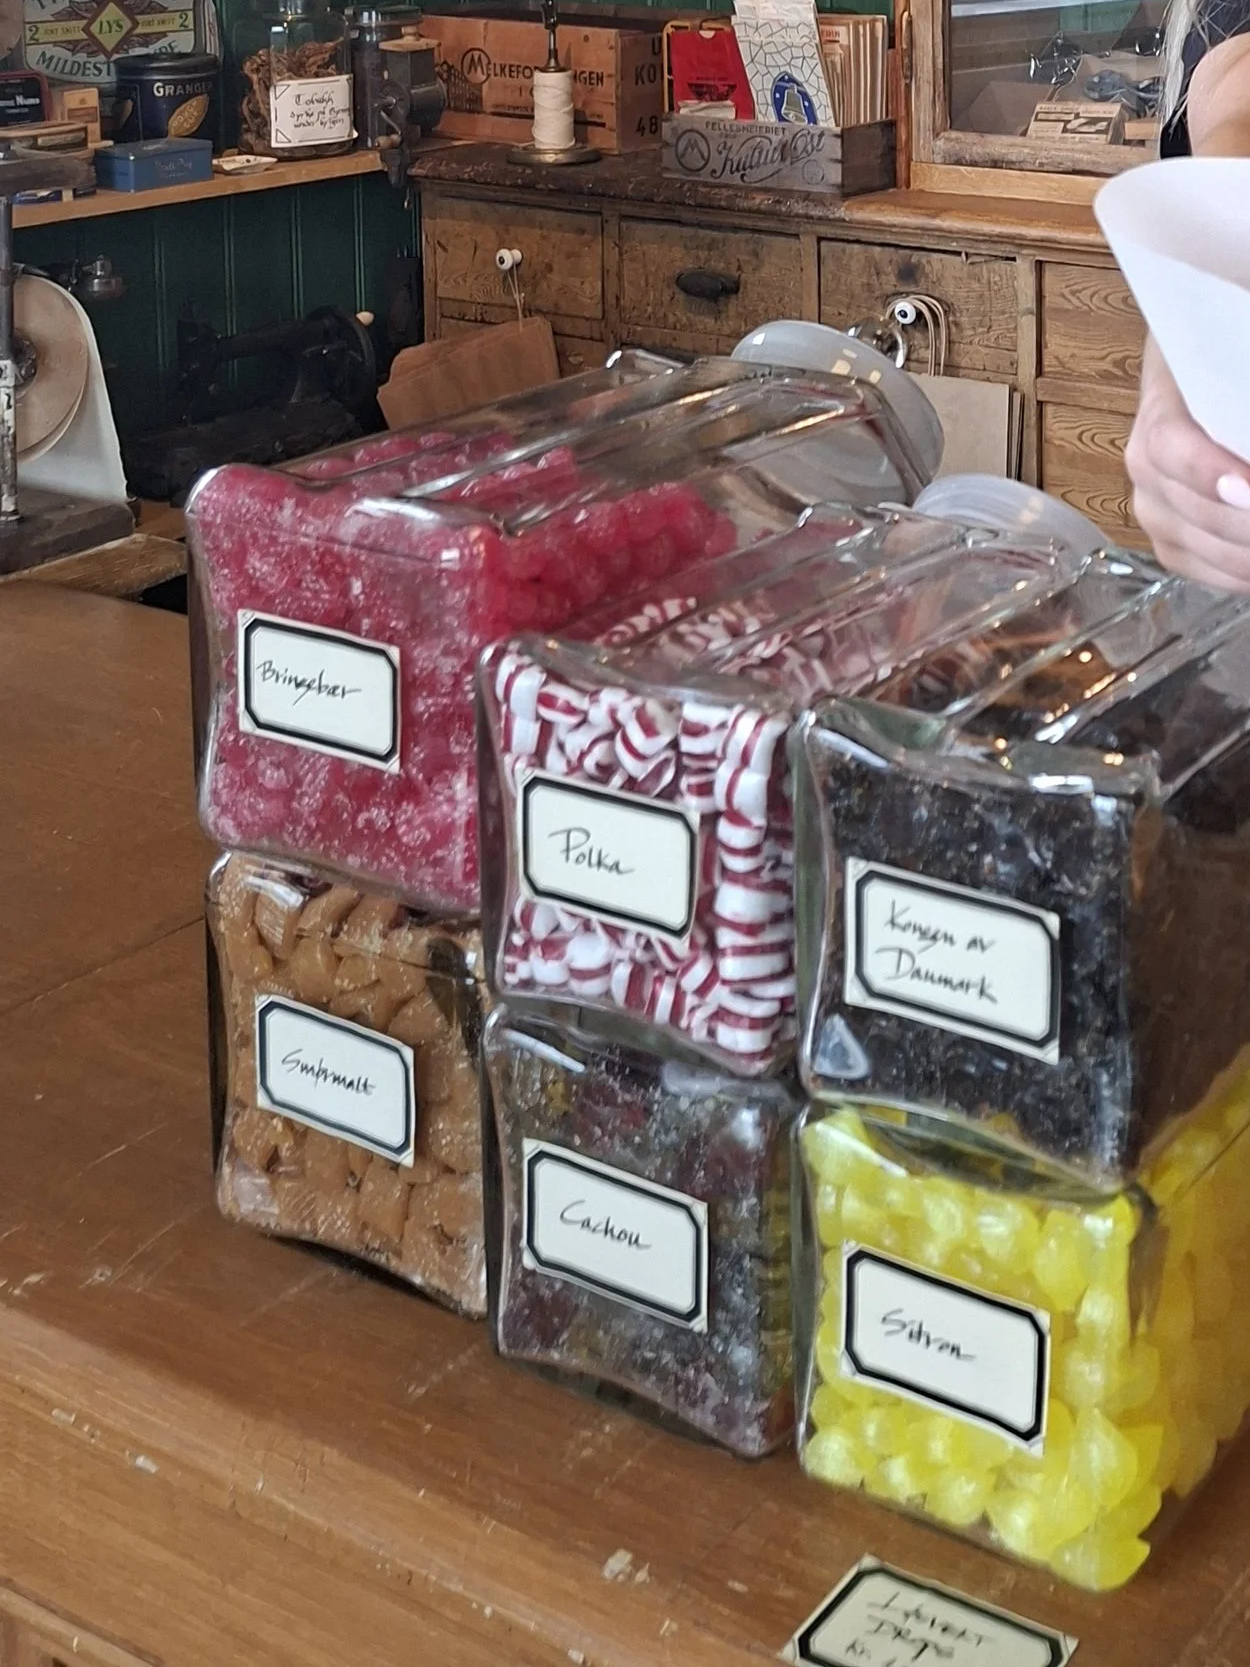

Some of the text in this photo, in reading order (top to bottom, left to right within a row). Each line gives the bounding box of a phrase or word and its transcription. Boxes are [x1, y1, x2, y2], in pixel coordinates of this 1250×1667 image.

[28, 24, 40, 43] 2
[98, 20, 124, 35] LYS
[179, 12, 189, 28] 2
[548, 827, 634, 875] Polka
[884, 899, 956, 953] Kongen
[875, 947, 998, 1004] Danmark
[560, 1200, 652, 1249] Cachou
